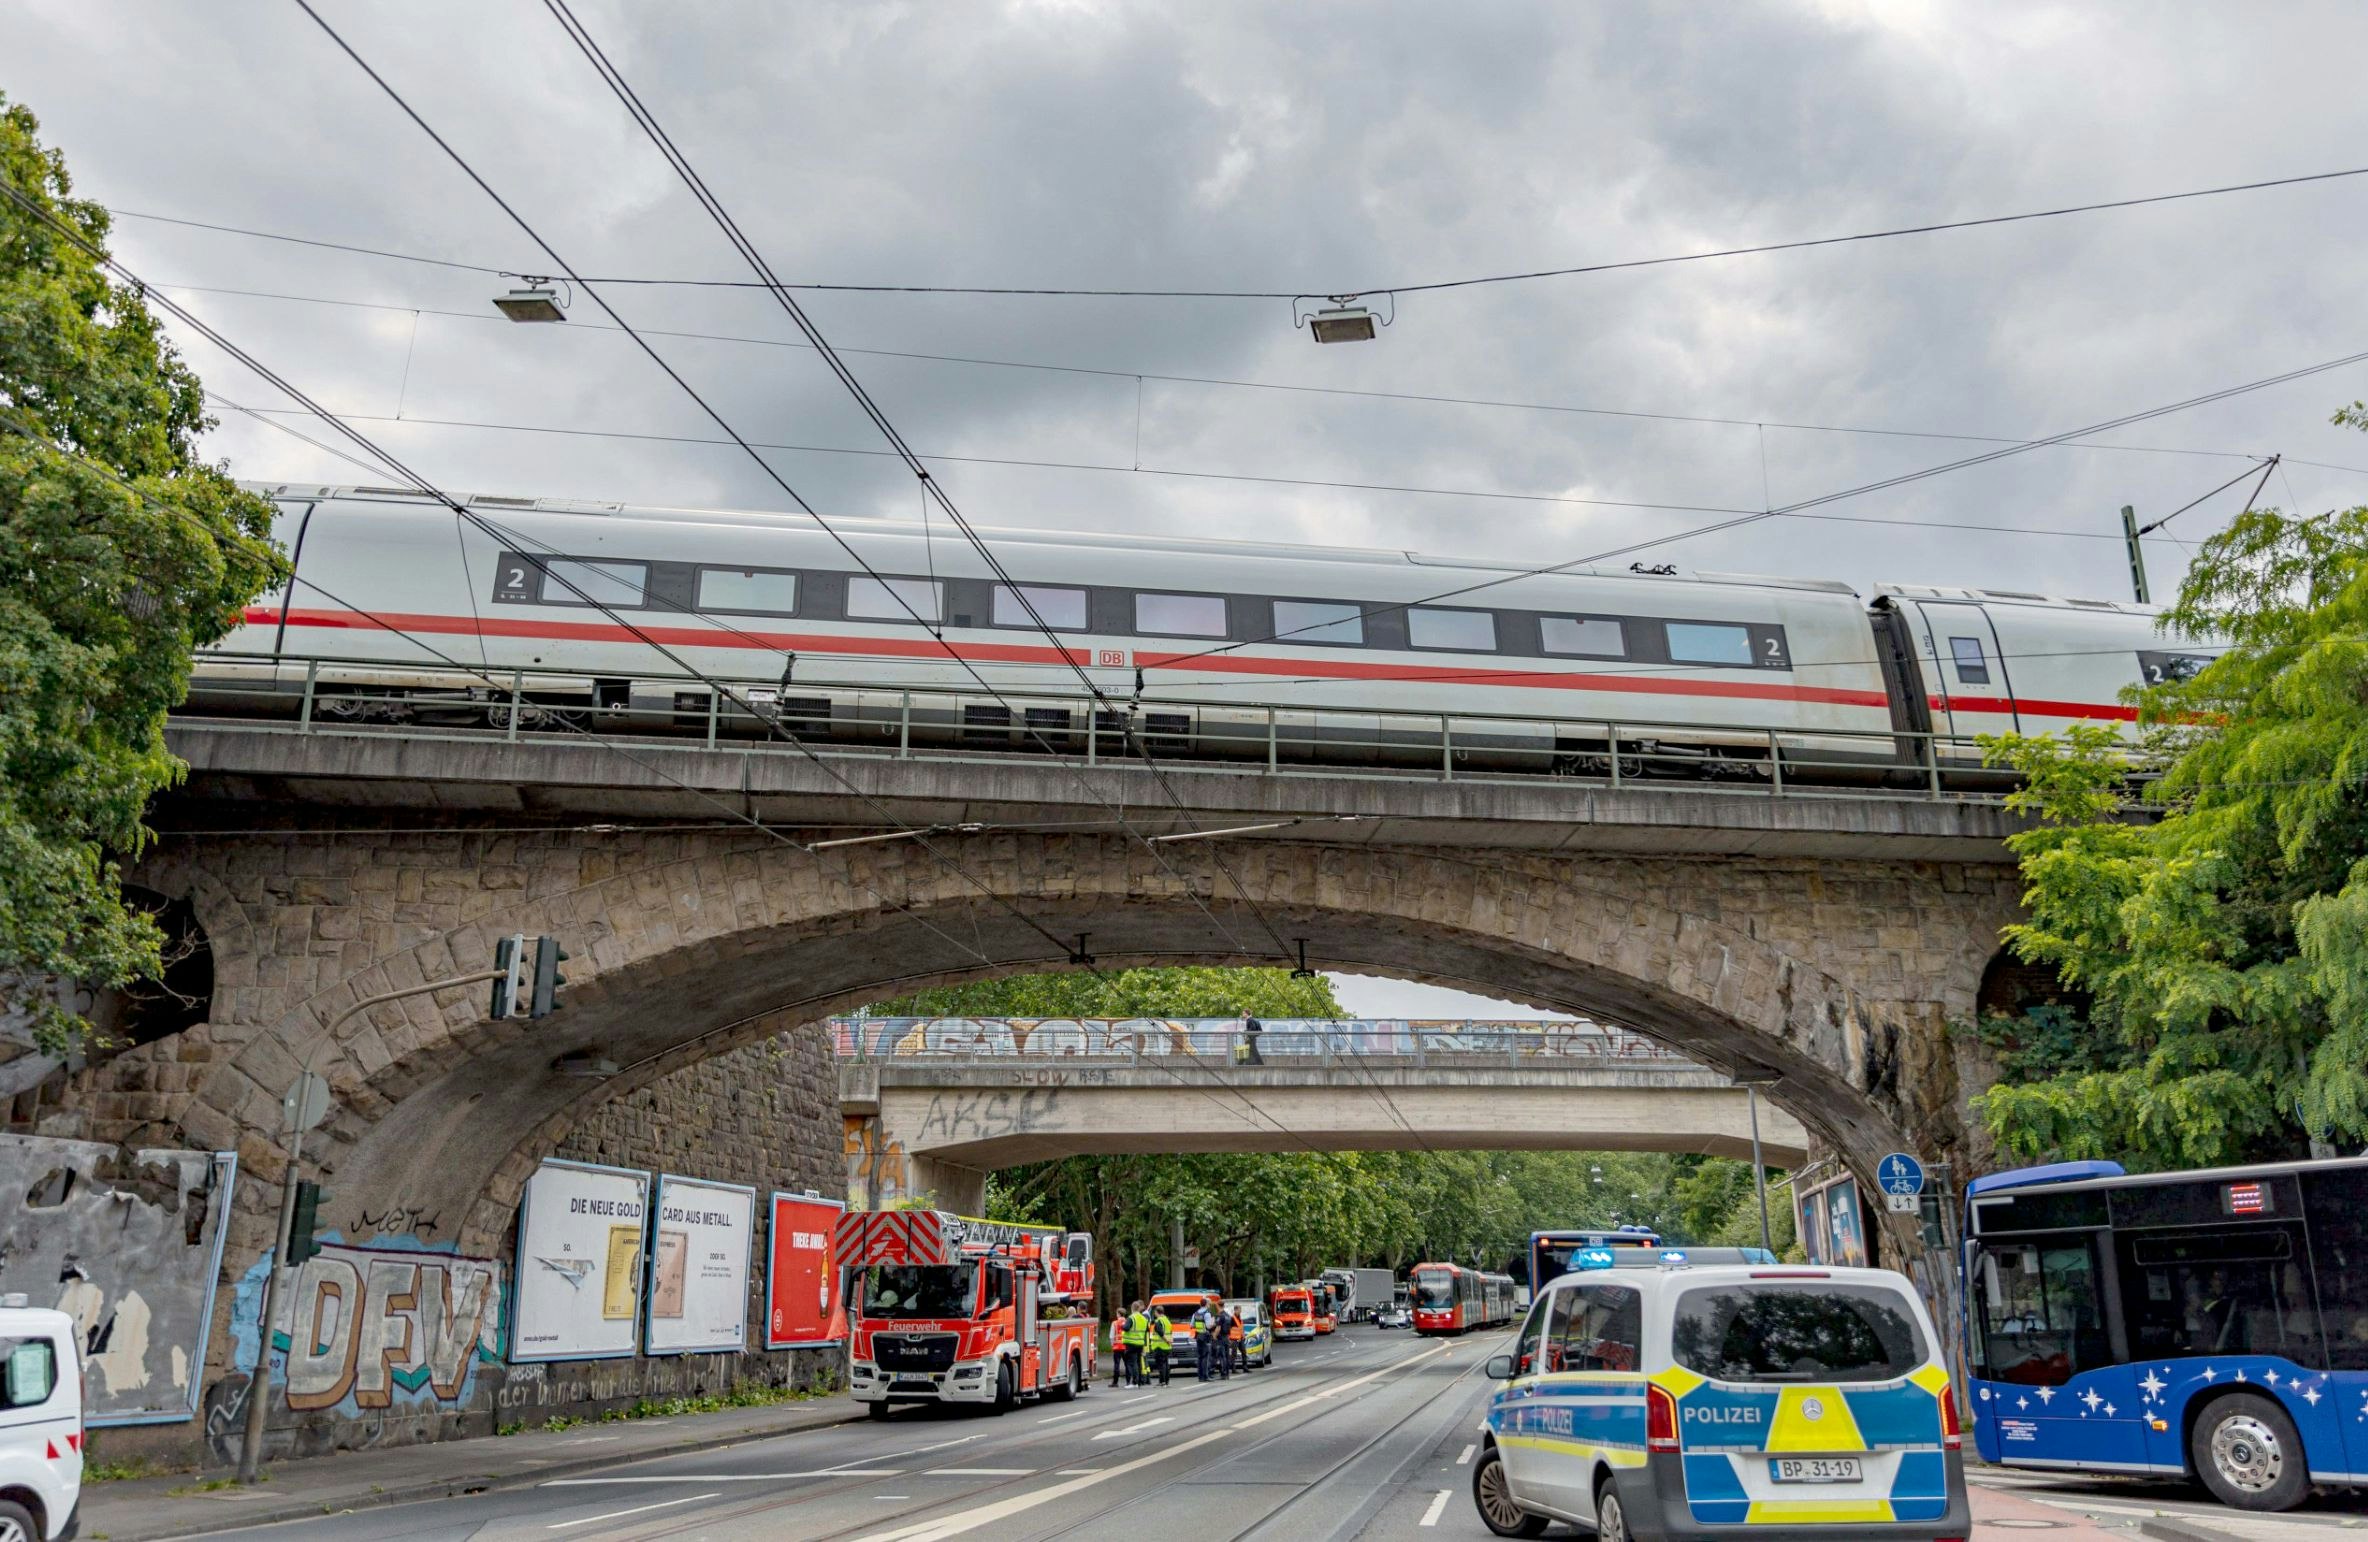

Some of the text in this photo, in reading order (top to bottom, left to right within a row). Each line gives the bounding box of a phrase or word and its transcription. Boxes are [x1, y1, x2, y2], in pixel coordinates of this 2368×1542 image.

[508, 568, 525, 588] 2
[1766, 638, 1781, 656] 2
[1102, 652, 1122, 664] DB
[2150, 665, 2165, 682] 2
[570, 1198, 641, 1217] DIE NEUE GOLD
[662, 1207, 733, 1227] CARD AUS METALL.
[793, 1231, 809, 1249] THEKE
[888, 1319, 943, 1332] Feuerwehr
[1543, 1407, 1573, 1434] POLIZEI
[1684, 1405, 1761, 1423] POLIZEI
[1782, 1460, 1853, 1477] BP 31-19
